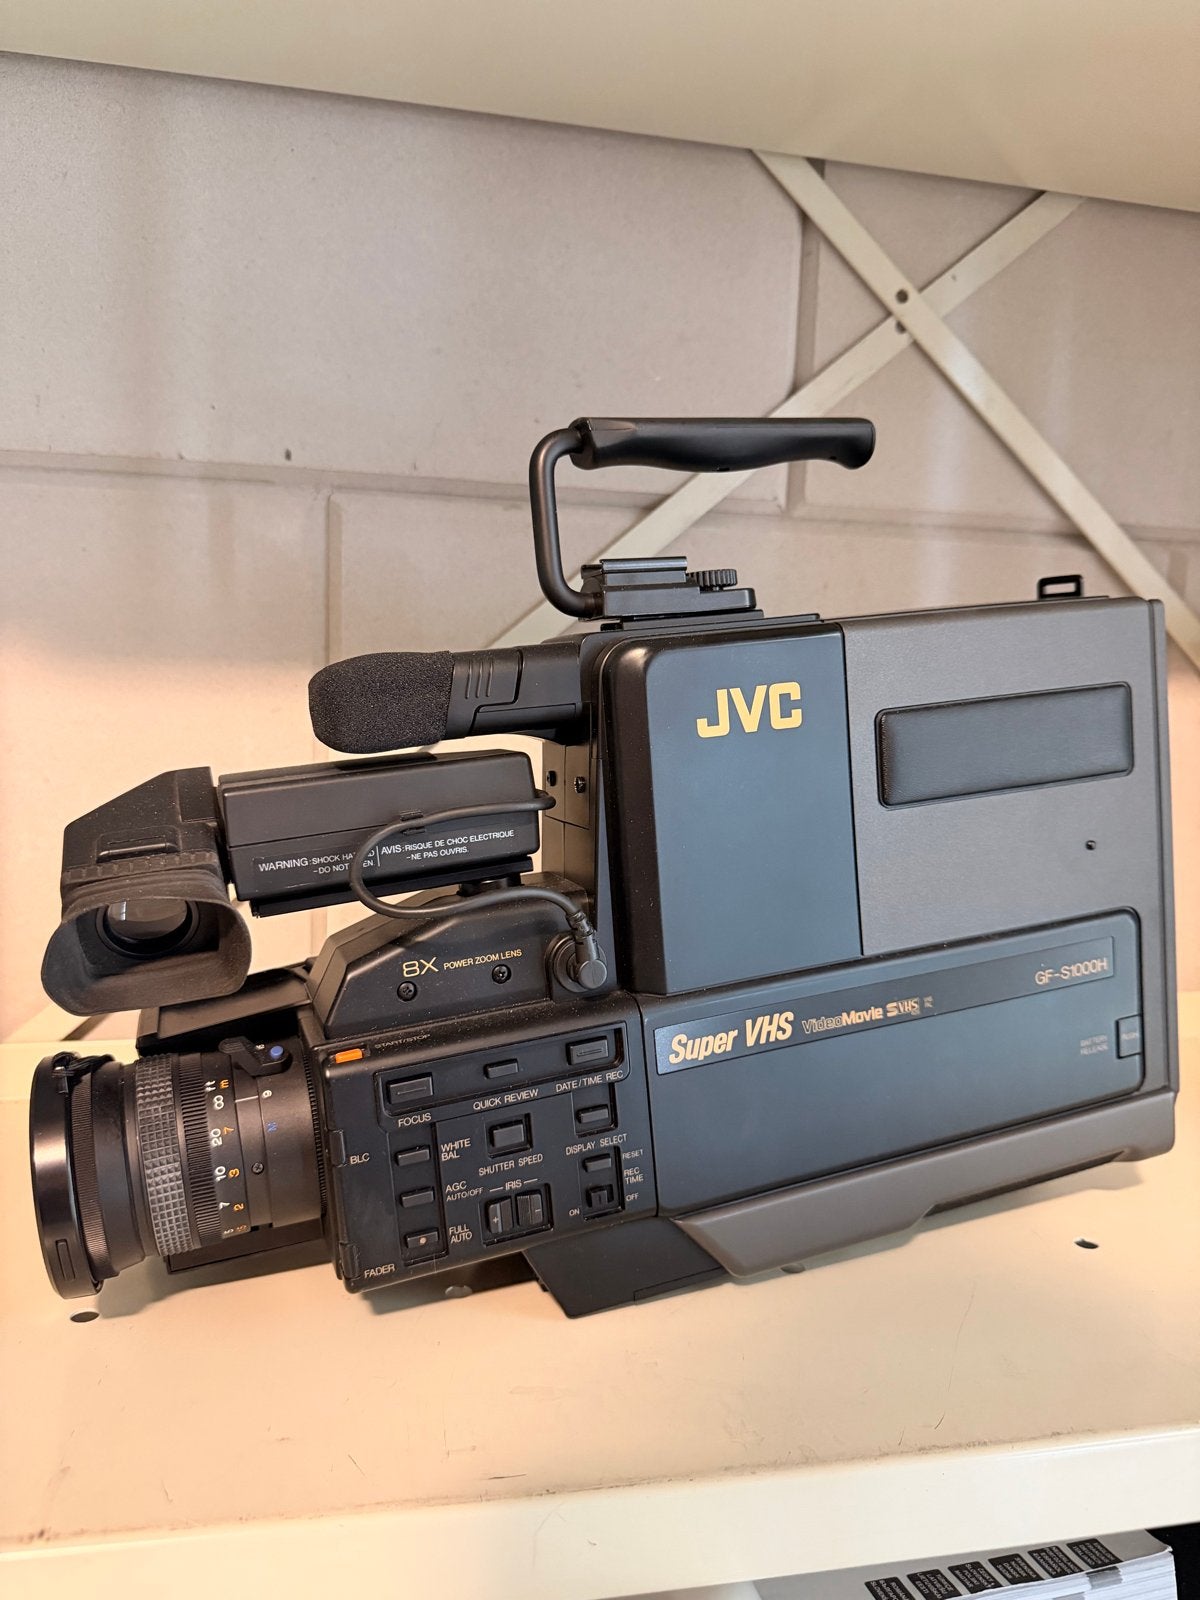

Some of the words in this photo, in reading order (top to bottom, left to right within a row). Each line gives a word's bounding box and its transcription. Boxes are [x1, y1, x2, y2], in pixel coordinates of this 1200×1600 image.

[697, 682, 802, 738] JVC
[435, 839, 445, 847] DE
[446, 836, 469, 846] CHOC
[469, 829, 515, 843] ELECTRIQUE
[423, 850, 438, 859] PAS
[333, 863, 350, 872] NOT
[402, 956, 439, 978] 8X
[443, 958, 474, 971] POWER
[474, 953, 500, 964] ZOOM
[500, 948, 523, 960] LENS
[1035, 957, 1108, 985] GF-S1000H
[669, 1029, 738, 1064] Super
[745, 1011, 794, 1047] VHS
[605, 1070, 624, 1081] REC
[220, 1079, 229, 1089] m
[473, 1097, 502, 1111] QUICK
[504, 1088, 539, 1105] REVIEW
[398, 1112, 432, 1128] FOCUS
[210, 1128, 223, 1147] 20
[441, 1138, 471, 1153] WHITE
[565, 1141, 596, 1156] DISPLAY
[600, 1133, 628, 1146] SELECT
[349, 1152, 370, 1165] BLC
[441, 1151, 460, 1162] BAL
[622, 1149, 644, 1160] RESET
[478, 1159, 515, 1177] SHUTTER
[518, 1153, 543, 1167] SPEED
[214, 1165, 227, 1182] 10
[228, 1168, 240, 1178] 3
[624, 1167, 640, 1178] REC
[505, 1179, 522, 1191] IRIS
[625, 1174, 644, 1185] TIME
[445, 1180, 467, 1193] AGC
[446, 1187, 483, 1202] AUTO/OFF
[626, 1192, 640, 1202] OFF
[219, 1201, 231, 1210] 7
[233, 1203, 245, 1212] 2
[569, 1207, 580, 1217] ON
[449, 1223, 470, 1236] FULL
[450, 1231, 473, 1244] AUTO
[364, 1263, 396, 1279] FADER
